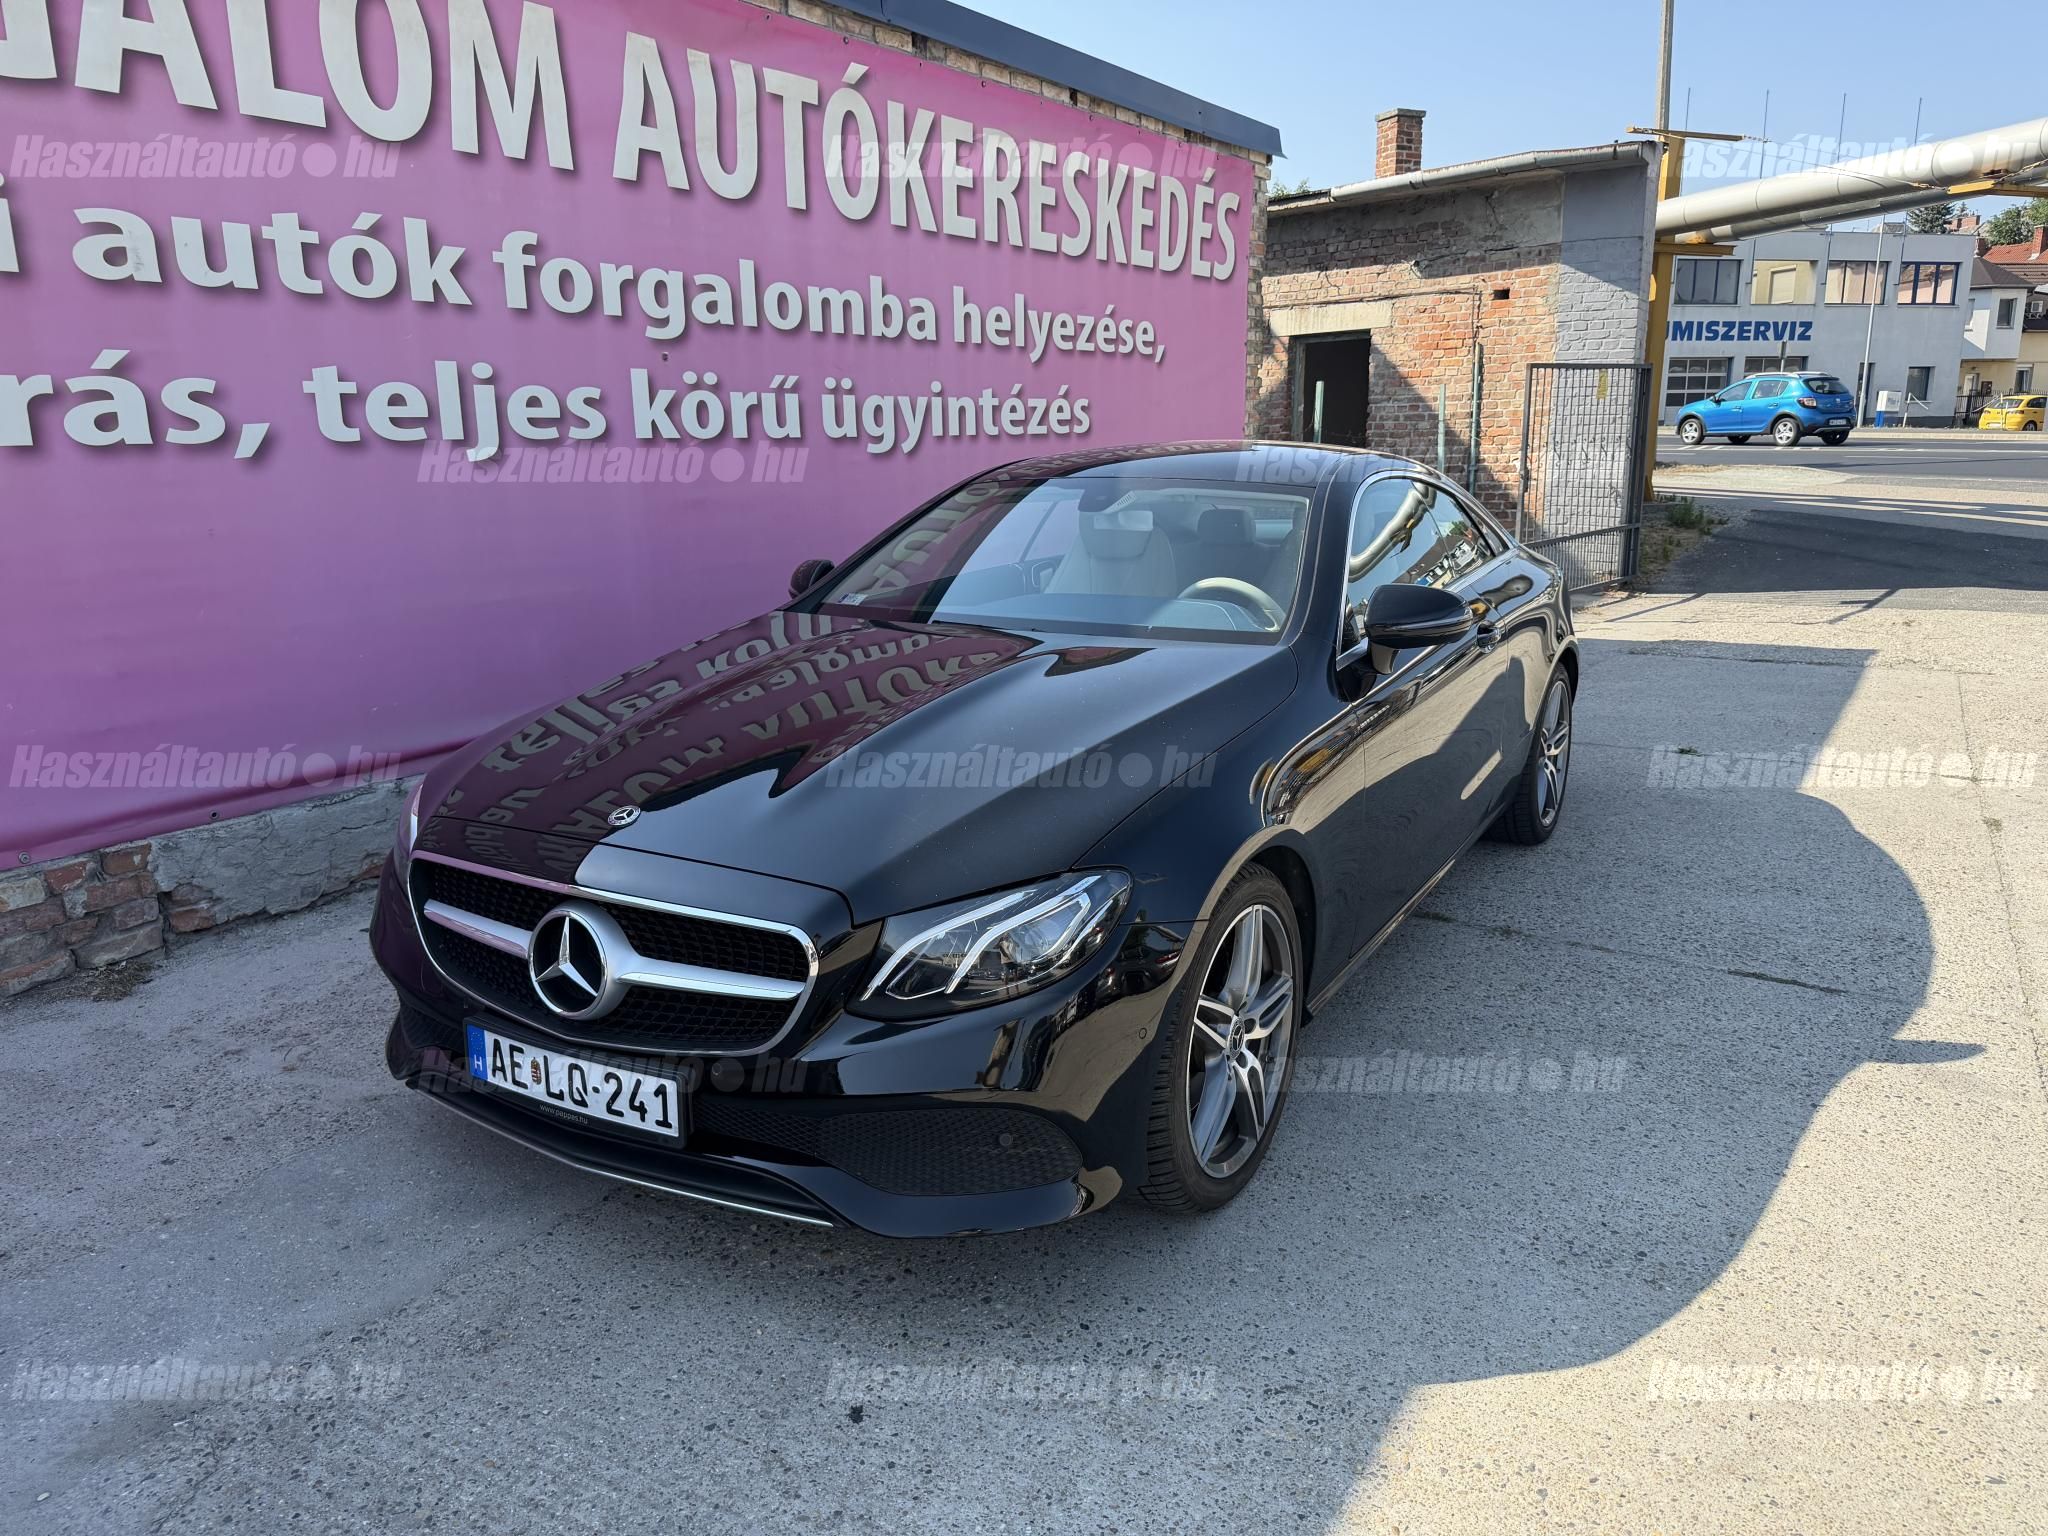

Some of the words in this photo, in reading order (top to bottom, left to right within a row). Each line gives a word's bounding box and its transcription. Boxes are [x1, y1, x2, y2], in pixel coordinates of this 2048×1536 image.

[0, 0, 574, 171] ALOM
[613, 31, 1240, 281] AUTÓKERESKEDÉS
[72, 207, 472, 306] autók
[493, 230, 937, 341] forgalomba
[953, 285, 1166, 364] helyezése,
[1665, 320, 1813, 342] MISZERVIZ
[302, 360, 607, 462] teljes
[630, 367, 801, 439] körű
[821, 376, 1090, 455] ügyintézés
